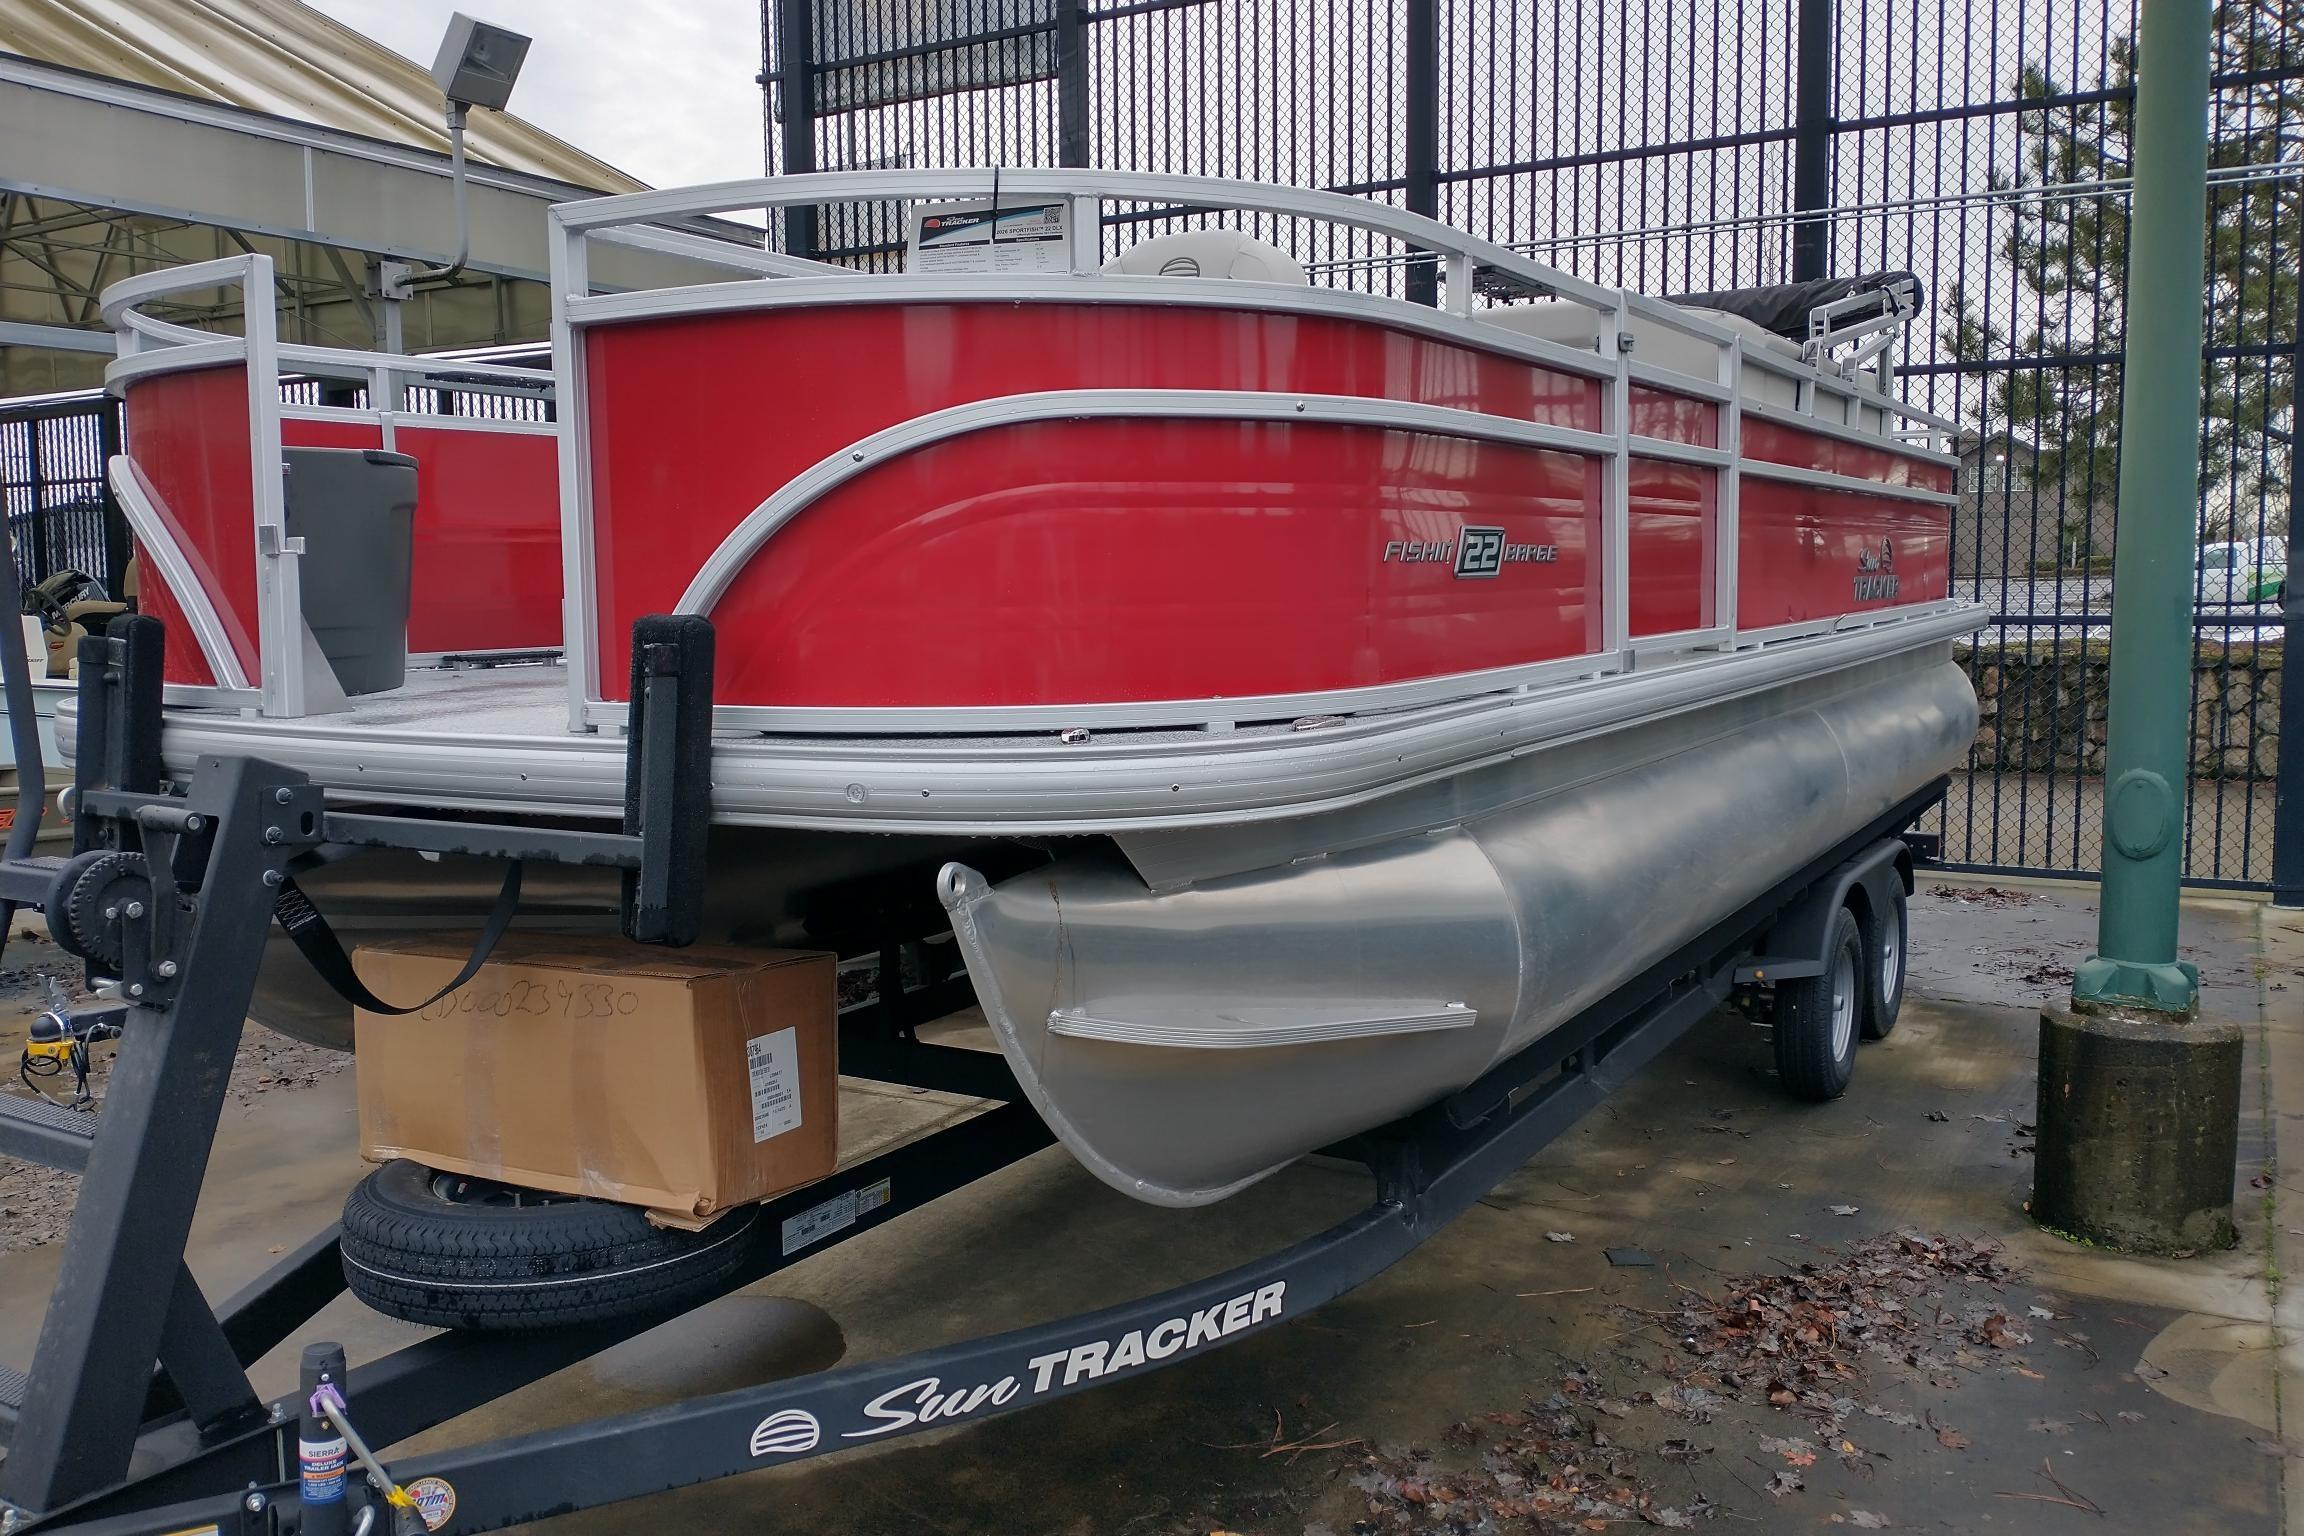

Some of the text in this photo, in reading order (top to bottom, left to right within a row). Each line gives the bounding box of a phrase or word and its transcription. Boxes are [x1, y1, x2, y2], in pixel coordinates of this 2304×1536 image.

[941, 218, 980, 227] TRACKER
[1464, 535, 1500, 569] 22
[1504, 543, 1559, 563] BARGE
[1853, 575, 1901, 601] TRACKER
[841, 1280, 1287, 1437] Sun TRACKER
[308, 1446, 340, 1458] SIERRA
[311, 1459, 337, 1467] DELUXE
